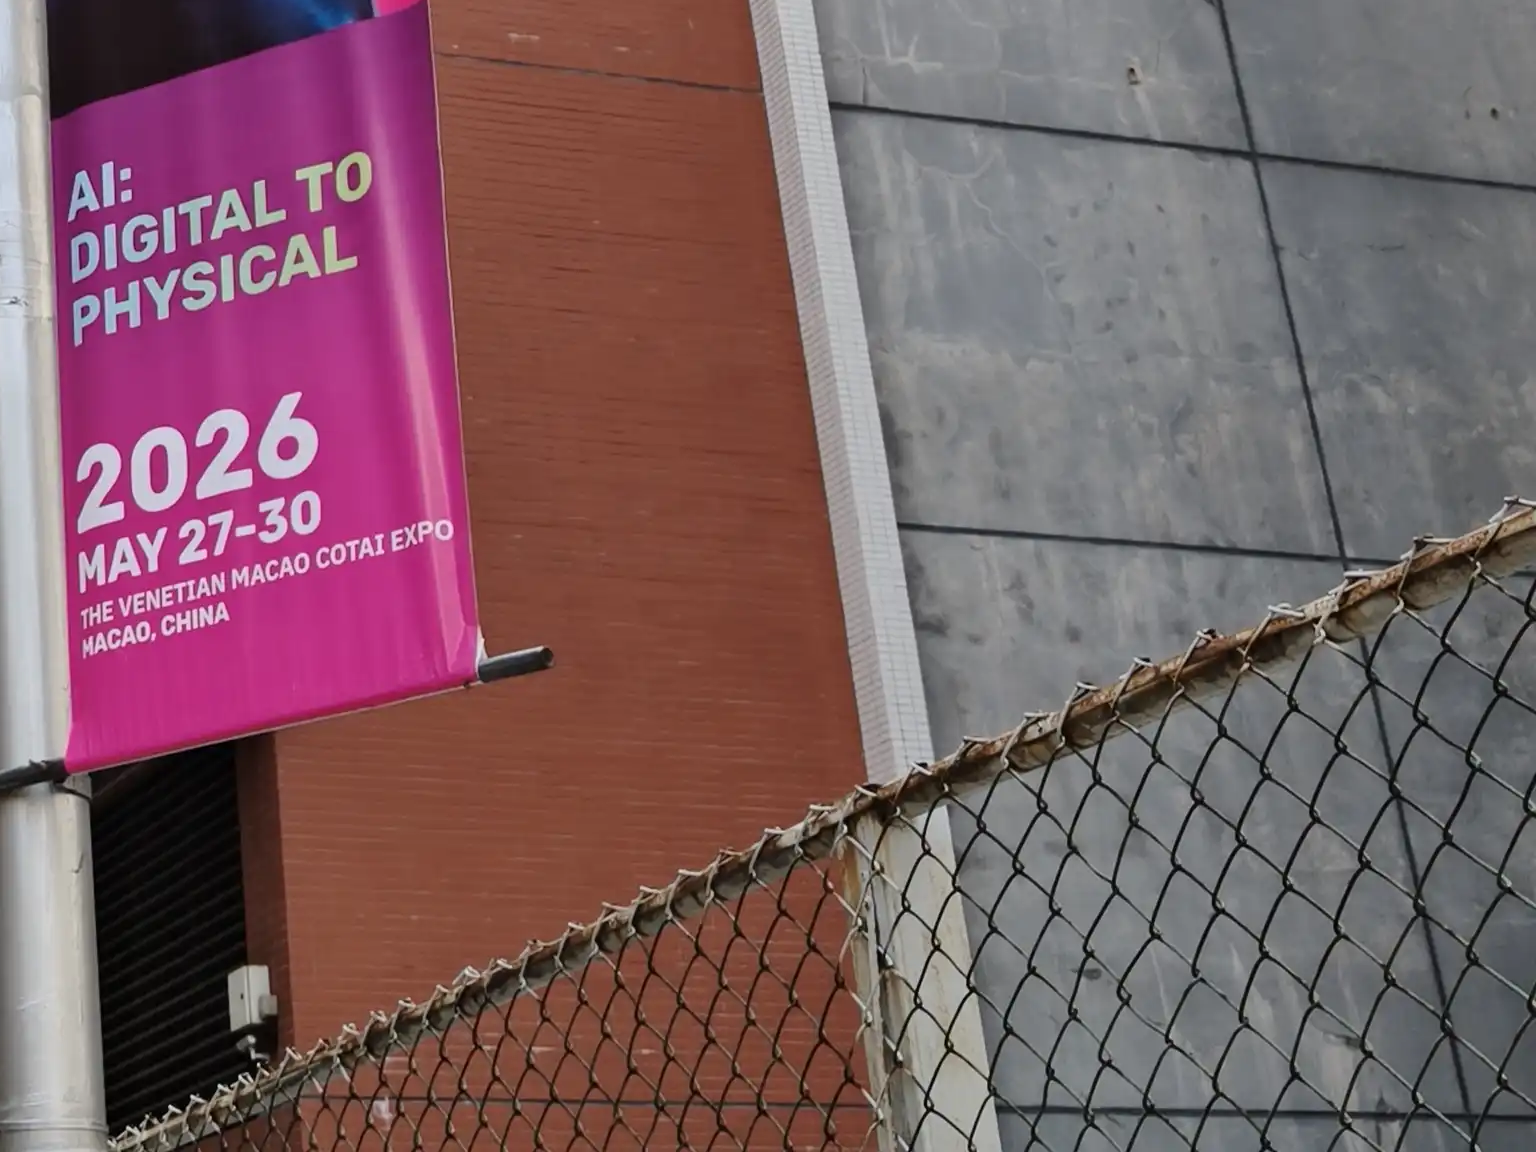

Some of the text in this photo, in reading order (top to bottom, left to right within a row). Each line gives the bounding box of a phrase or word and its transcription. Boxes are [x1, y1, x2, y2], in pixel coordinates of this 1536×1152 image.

[68, 161, 133, 222] AI:
[71, 151, 372, 283] DIGITAL TO
[73, 226, 358, 347] PHYSICAL
[77, 392, 319, 534] 2026
[78, 490, 321, 594] MAY 27-30
[81, 519, 454, 629] THE VENETIAN MACAO COTAI EXPO
[82, 602, 230, 659] MACAO, CHINA
